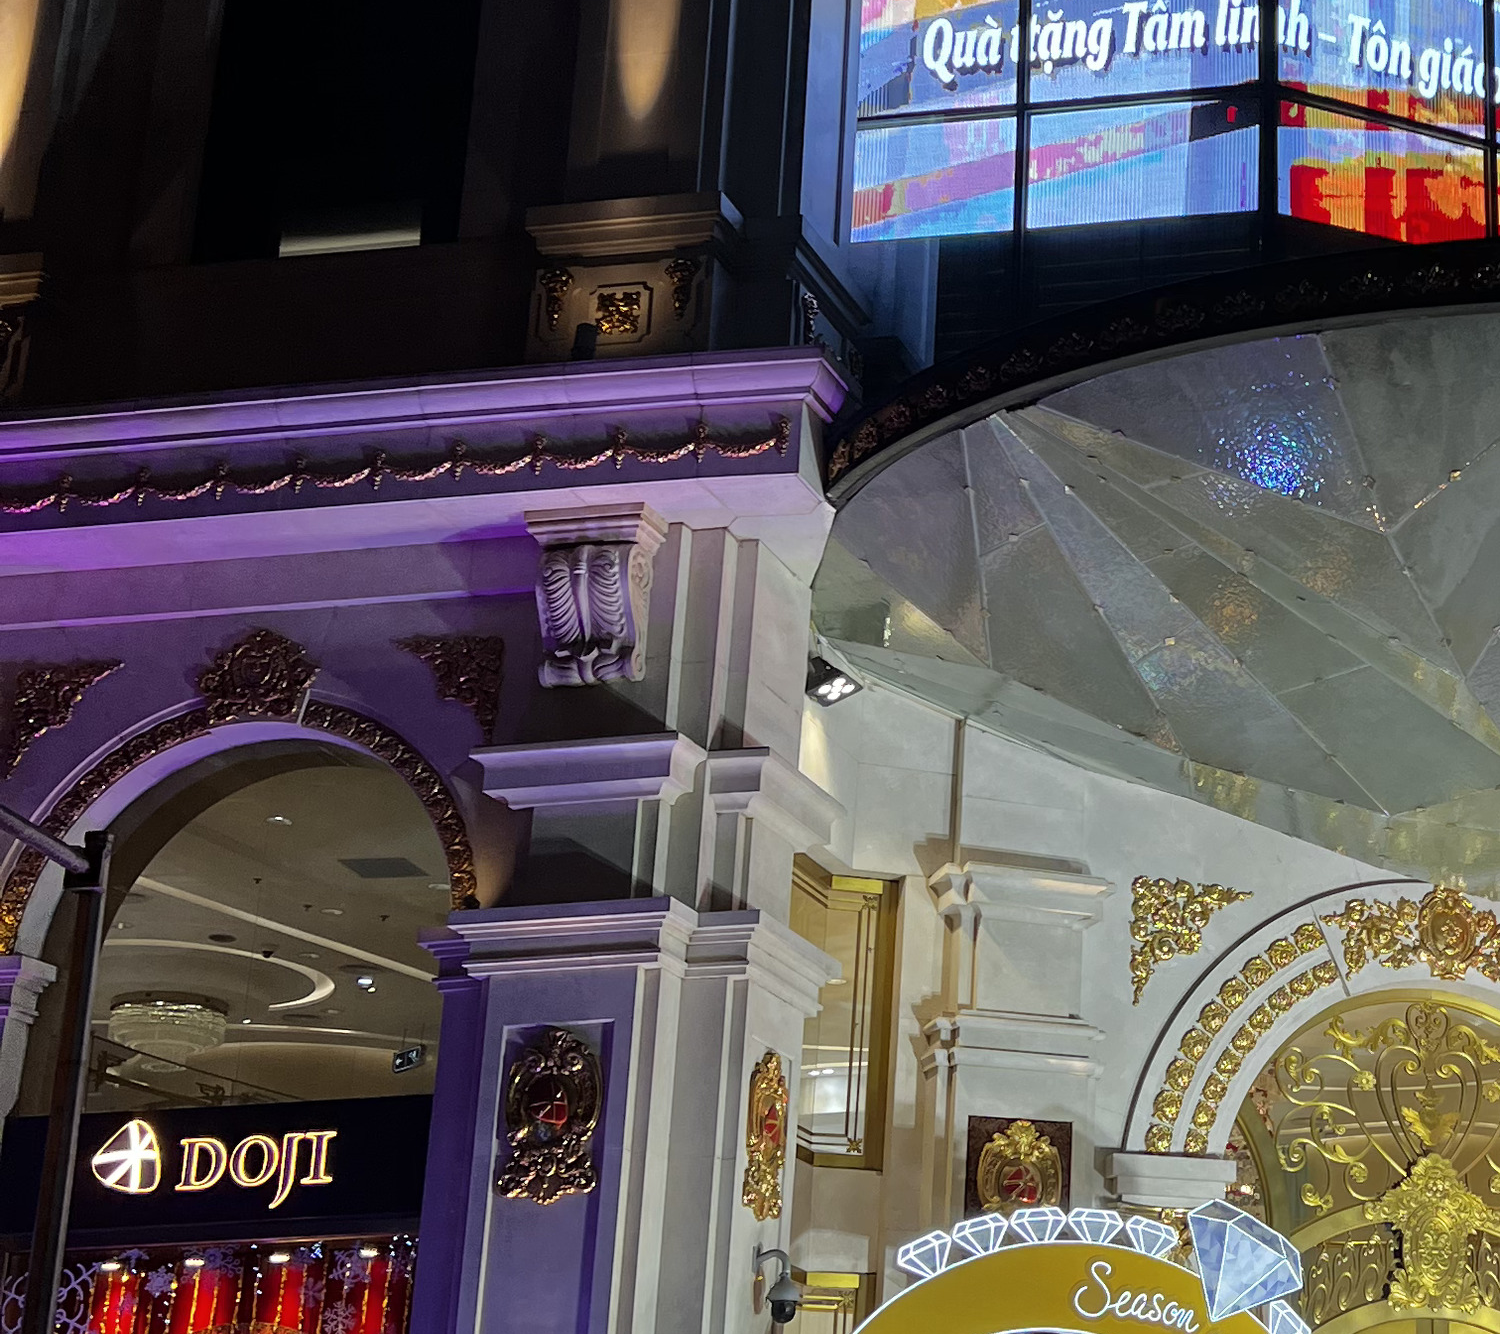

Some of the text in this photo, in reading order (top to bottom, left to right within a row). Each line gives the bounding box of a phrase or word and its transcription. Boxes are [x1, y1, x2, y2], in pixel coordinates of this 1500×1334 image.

[922, 14, 1004, 84] Quà
[1347, 13, 1412, 80] Tôn
[175, 1129, 338, 1210] DOJI
[1073, 1260, 1200, 1334] Season
